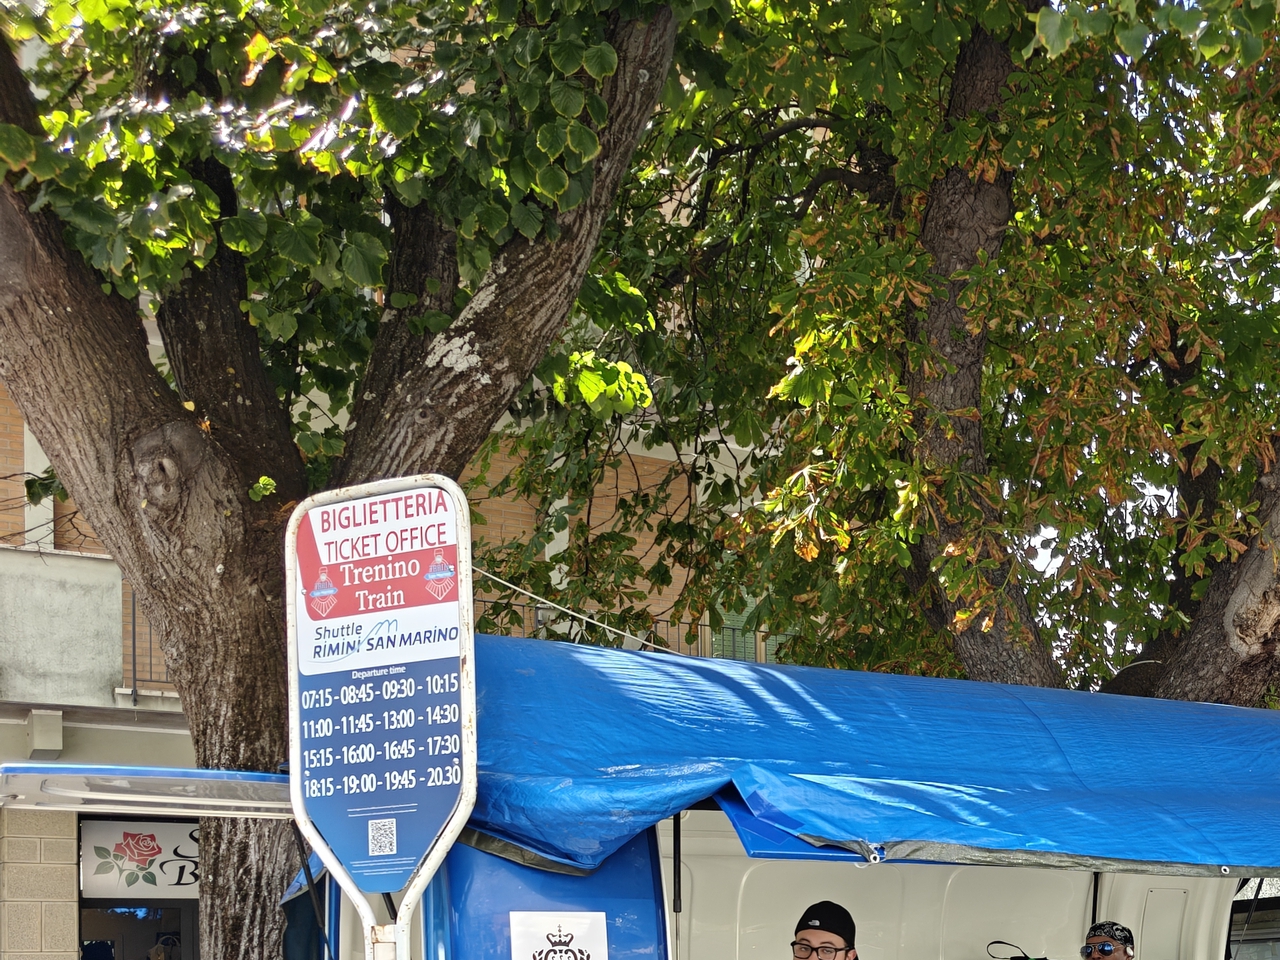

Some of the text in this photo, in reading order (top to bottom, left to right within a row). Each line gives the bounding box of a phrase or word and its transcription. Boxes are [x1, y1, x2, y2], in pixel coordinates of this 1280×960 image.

[322, 490, 448, 532] BIGLIETTERIA
[324, 522, 447, 562] TICKET OFFICE
[340, 556, 420, 587] Trenino
[356, 586, 405, 611] Train
[314, 622, 362, 640] Shuttle
[366, 635, 396, 652] SAN
[352, 665, 406, 680] Departure time
[302, 689, 332, 710] 07:15
[340, 684, 374, 704] 08:45
[382, 678, 415, 700] 09:30
[426, 673, 458, 694] 10:15
[302, 718, 332, 738] 11:00
[341, 714, 374, 734] 11:45
[383, 709, 414, 730] 13:00
[426, 704, 459, 725] 14:30
[304, 748, 333, 768] 15:15
[342, 744, 374, 764] 16:00
[384, 739, 415, 760] 16:45
[427, 734, 460, 756] 17:30
[304, 778, 334, 798] 18:15
[342, 774, 376, 794] 19:00
[384, 770, 416, 790] 19:45
